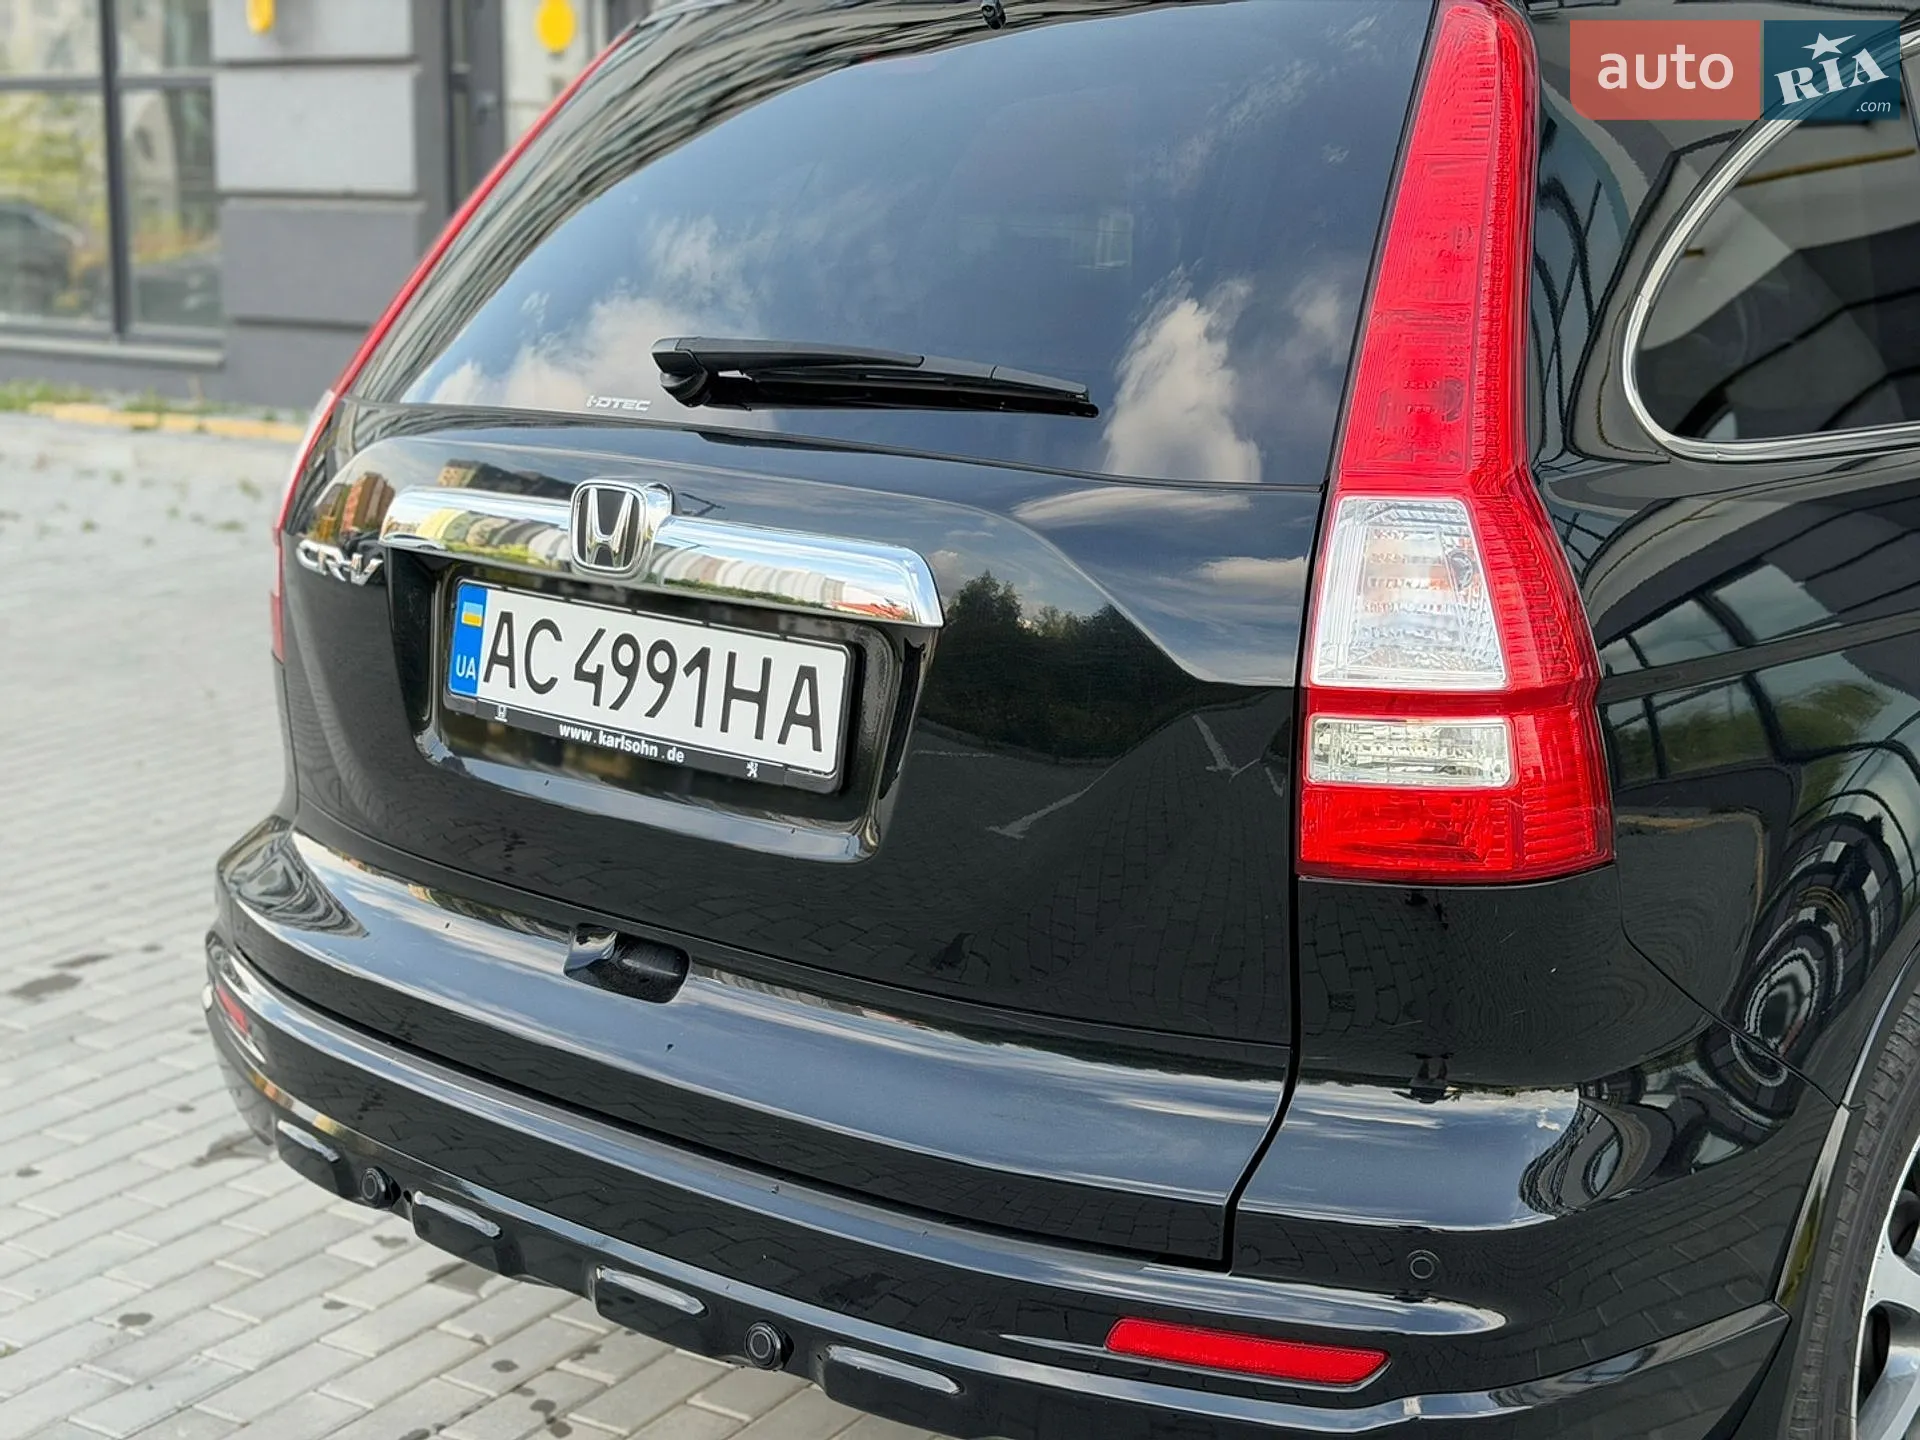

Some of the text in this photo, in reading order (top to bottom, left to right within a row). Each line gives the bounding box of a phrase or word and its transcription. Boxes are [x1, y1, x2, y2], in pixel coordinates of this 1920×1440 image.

[297, 539, 384, 586] CR-V
[456, 654, 477, 679] UA
[483, 610, 823, 753] AC 4991 HA
